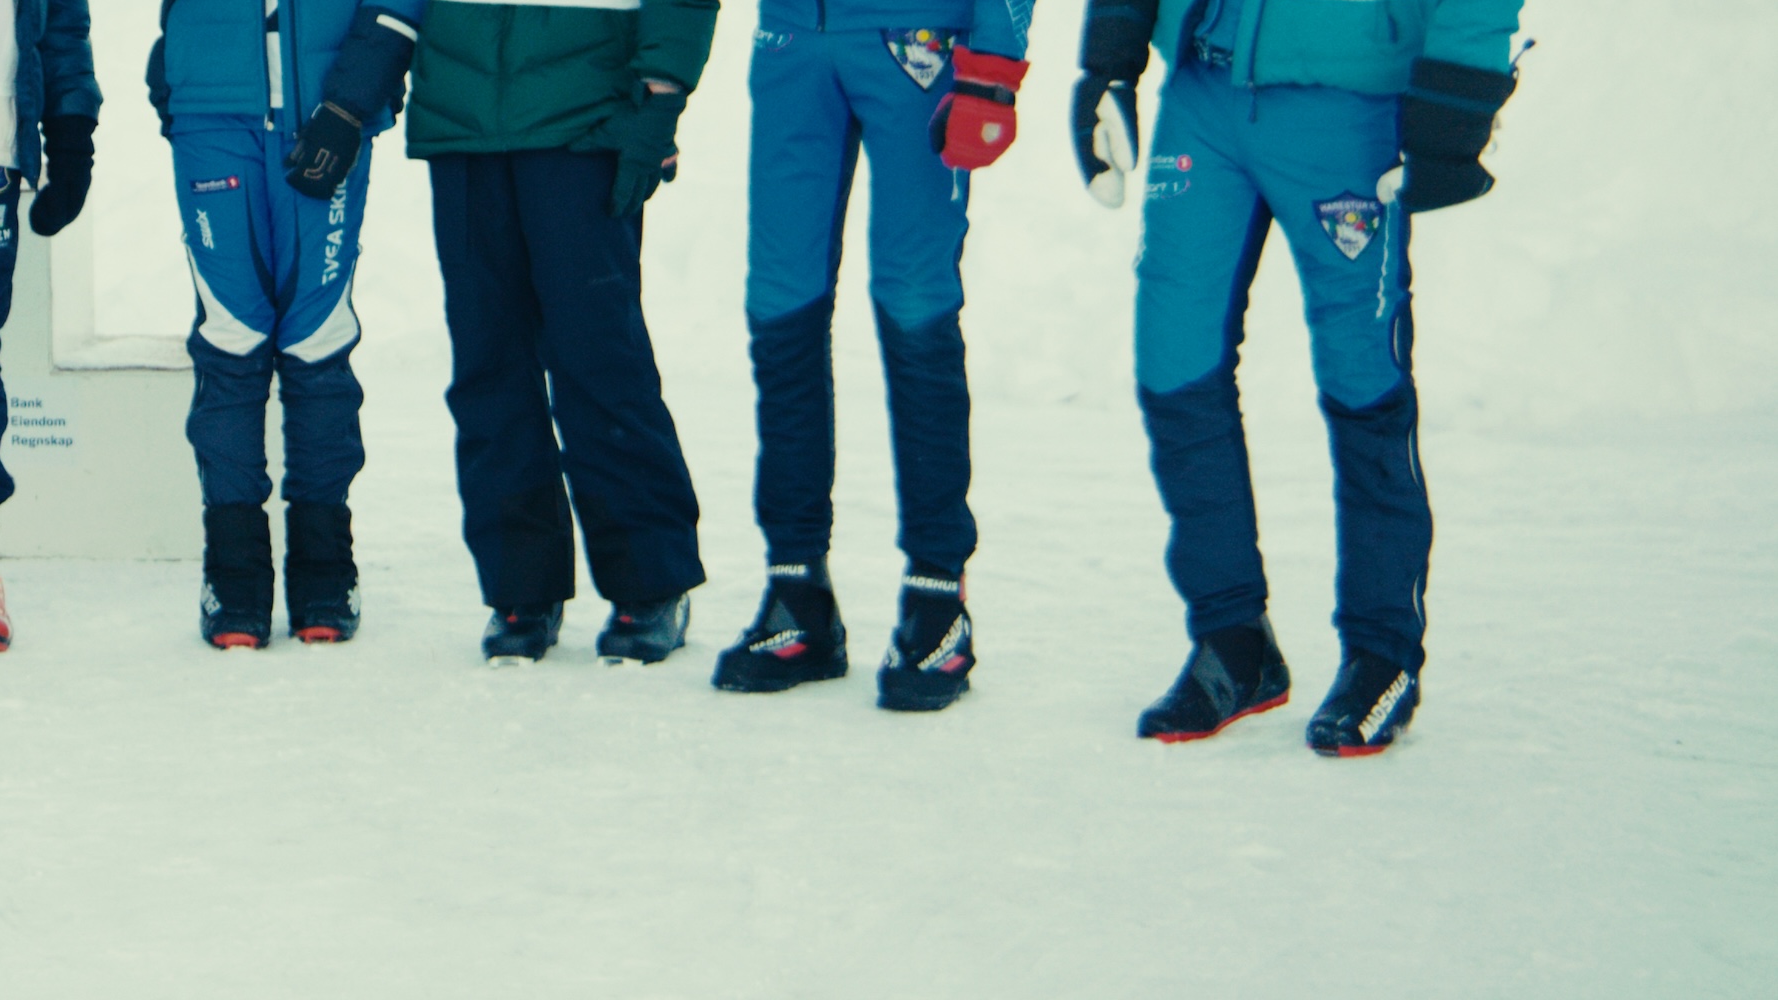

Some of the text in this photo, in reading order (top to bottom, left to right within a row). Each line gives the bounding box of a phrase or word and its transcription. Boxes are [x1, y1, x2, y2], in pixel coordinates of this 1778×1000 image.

[328, 178, 348, 226] SKIL
[11, 398, 42, 408] Bank
[11, 416, 66, 427] Eiendom
[11, 435, 74, 448] Regnskap
